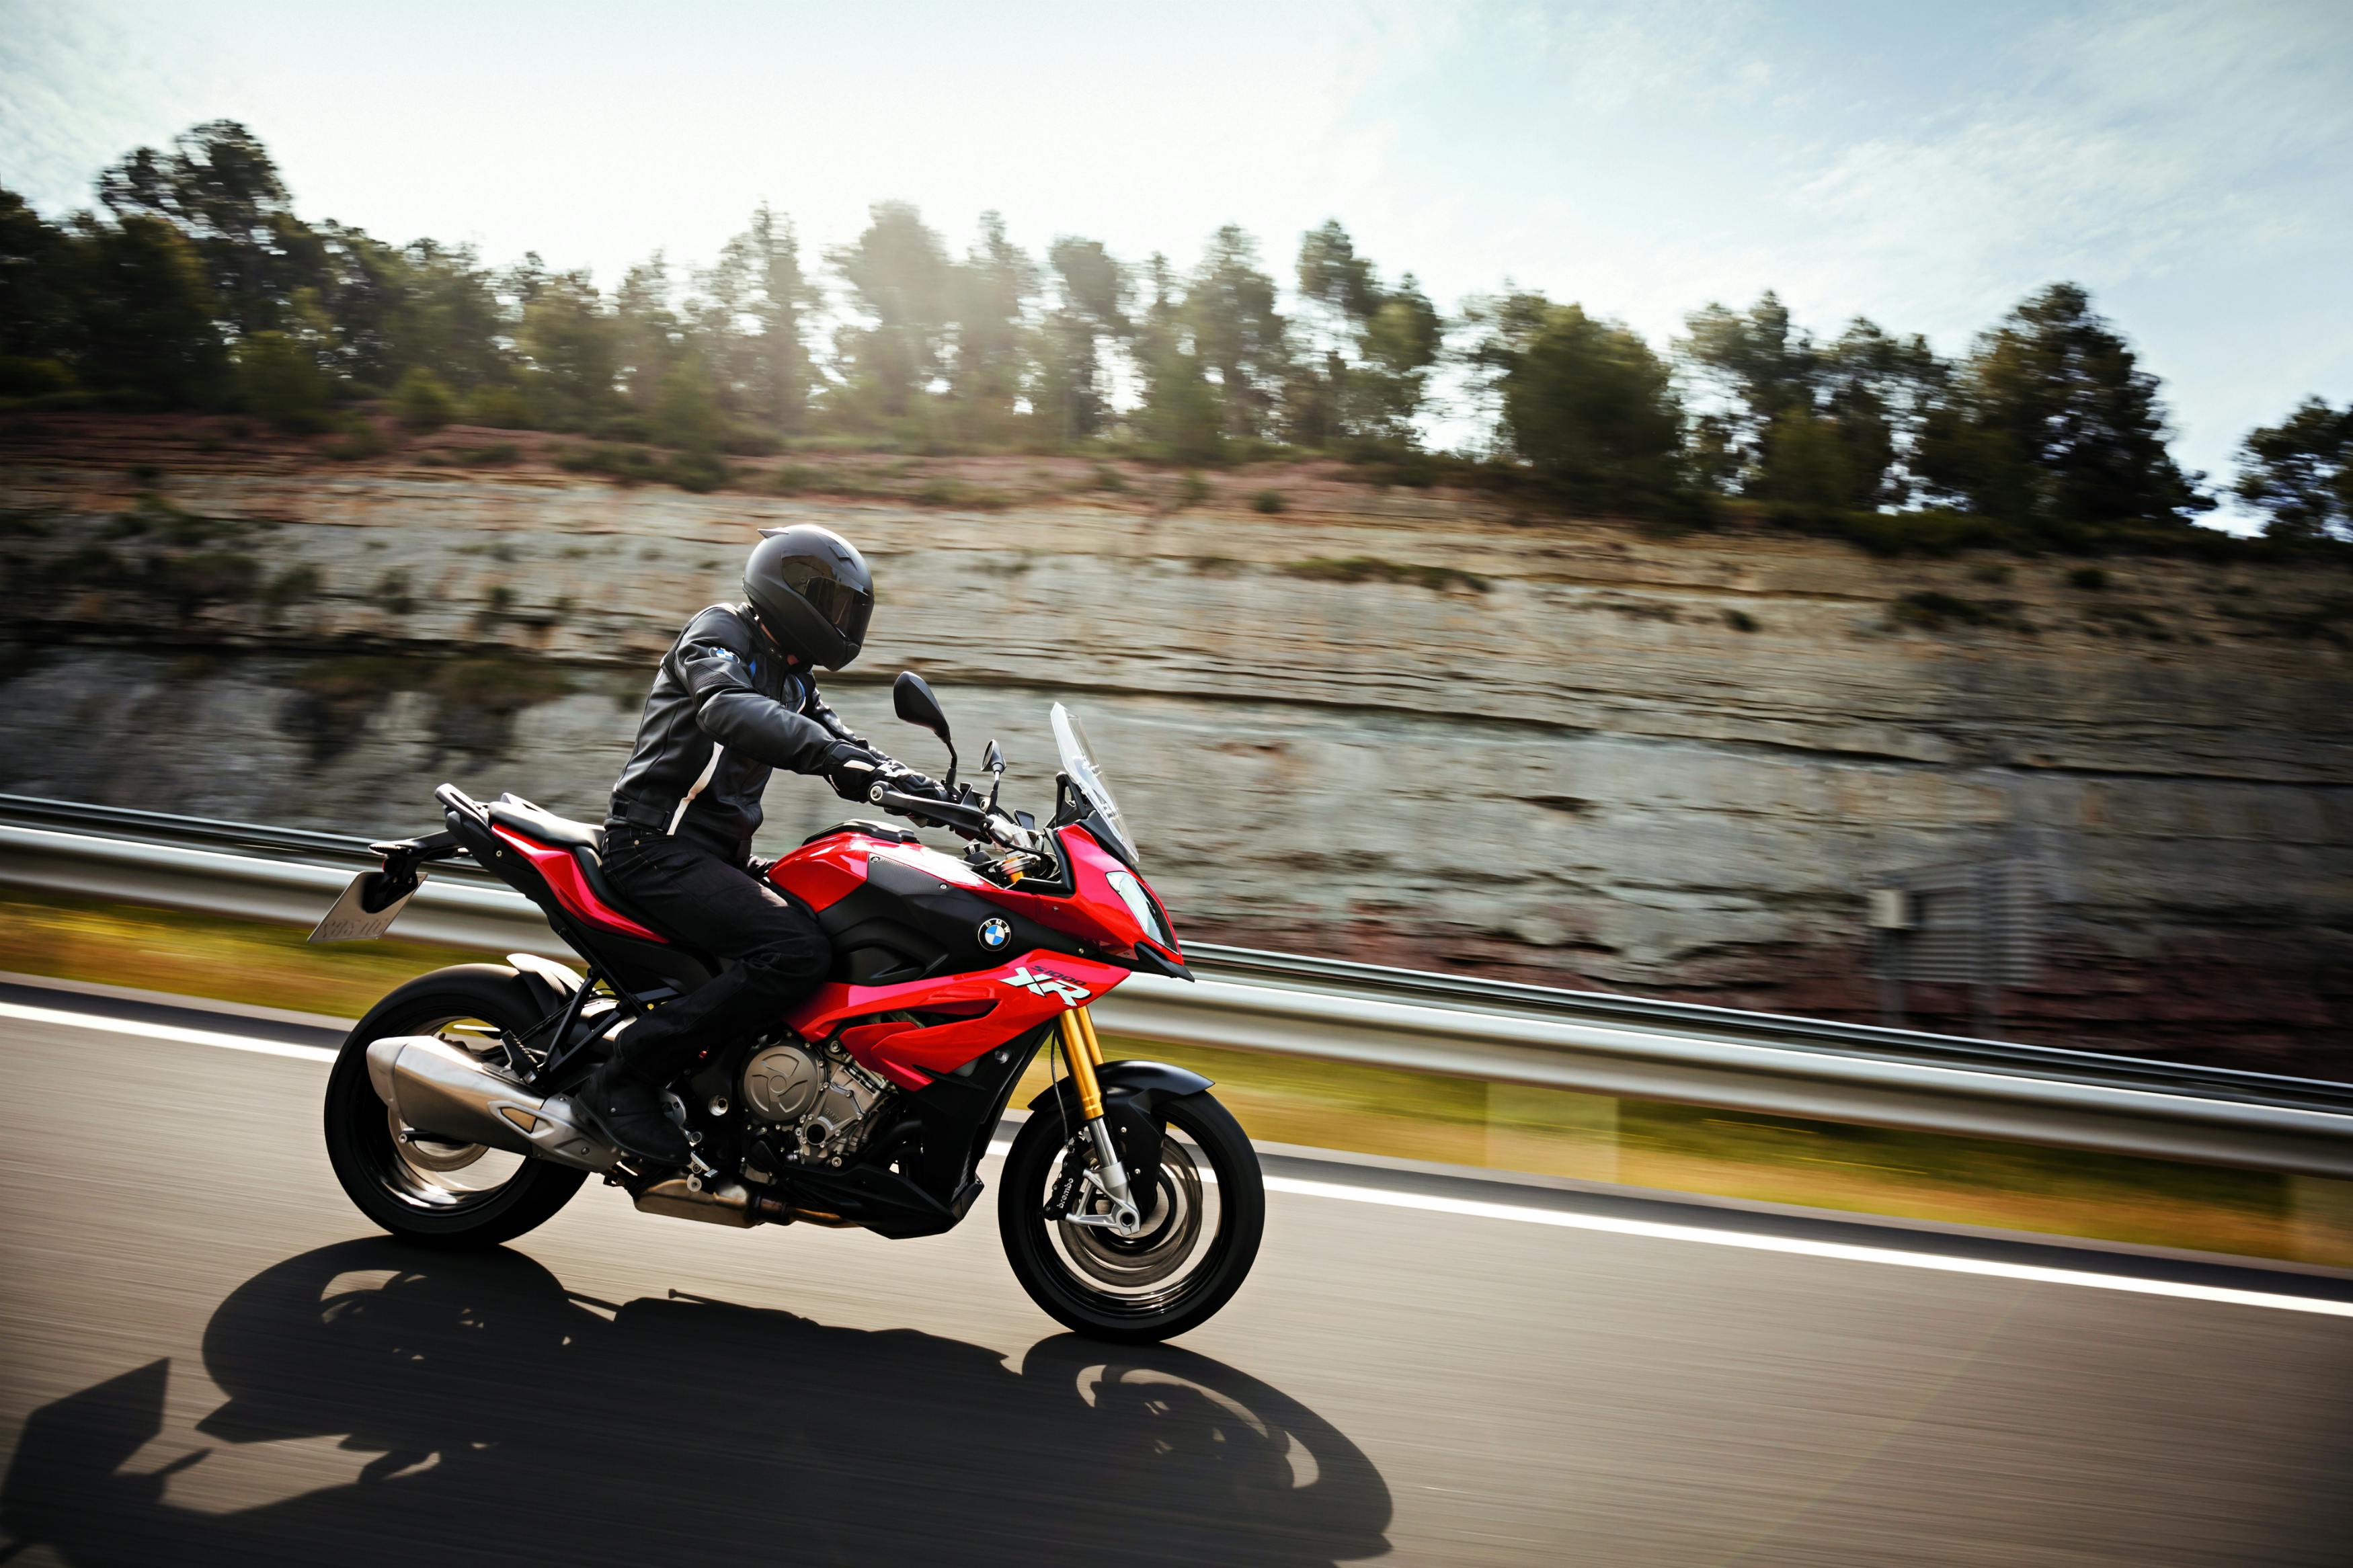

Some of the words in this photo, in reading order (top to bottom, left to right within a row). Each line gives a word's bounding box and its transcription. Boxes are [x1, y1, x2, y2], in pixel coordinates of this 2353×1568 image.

[985, 919, 1010, 933] BMW
[999, 966, 1092, 1007] XR
[1056, 1178, 1074, 1209] brembo
